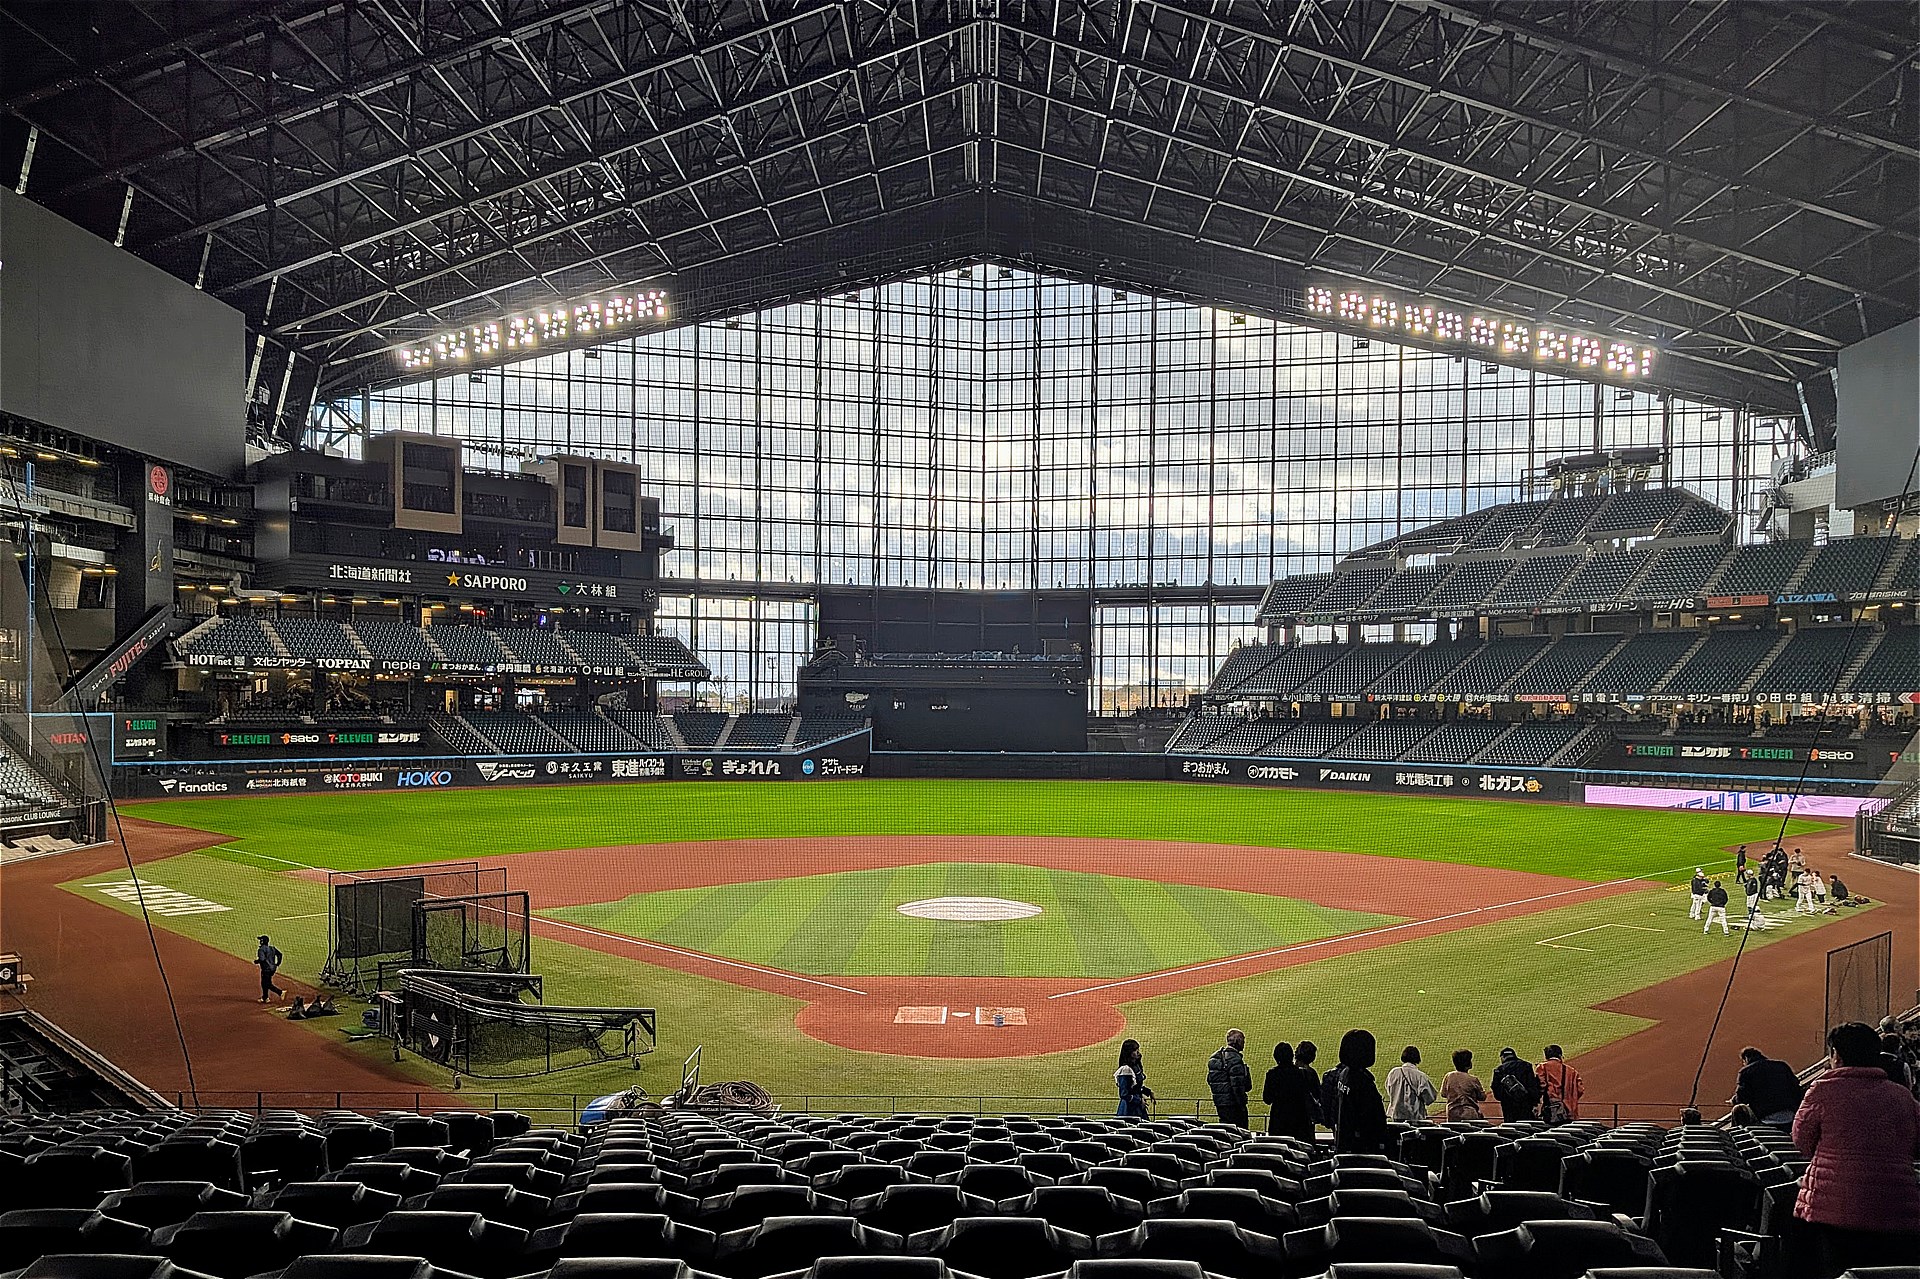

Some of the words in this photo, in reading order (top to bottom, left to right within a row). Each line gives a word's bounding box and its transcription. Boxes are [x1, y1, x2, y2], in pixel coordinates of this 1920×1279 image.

[329, 565, 412, 584] 北海道新聞社
[464, 574, 527, 591] SAPPORO
[575, 583, 617, 598] 大林組
[1589, 601, 1638, 612] 東洋グリーン
[1668, 598, 1695, 610] HIS
[109, 636, 148, 678] FUJITEC
[316, 658, 371, 669] TOPPAN
[382, 660, 421, 671] nepia
[593, 666, 625, 676] 中山組
[1769, 692, 1813, 703] 田中組
[611, 759, 639, 777] 東進
[722, 760, 781, 775] ぎょれん
[821, 758, 839, 766] アサヒ
[1182, 761, 1230, 775] まつおかまん
[821, 764, 864, 775] スーパードライ
[1258, 766, 1299, 780] オカモト
[333, 772, 383, 782] KOTOBUKI
[1330, 771, 1371, 782] DAIKIN
[1395, 772, 1454, 788] 東光電気工事
[178, 781, 228, 793] Fanatics
[1479, 774, 1526, 793] 北ガス
